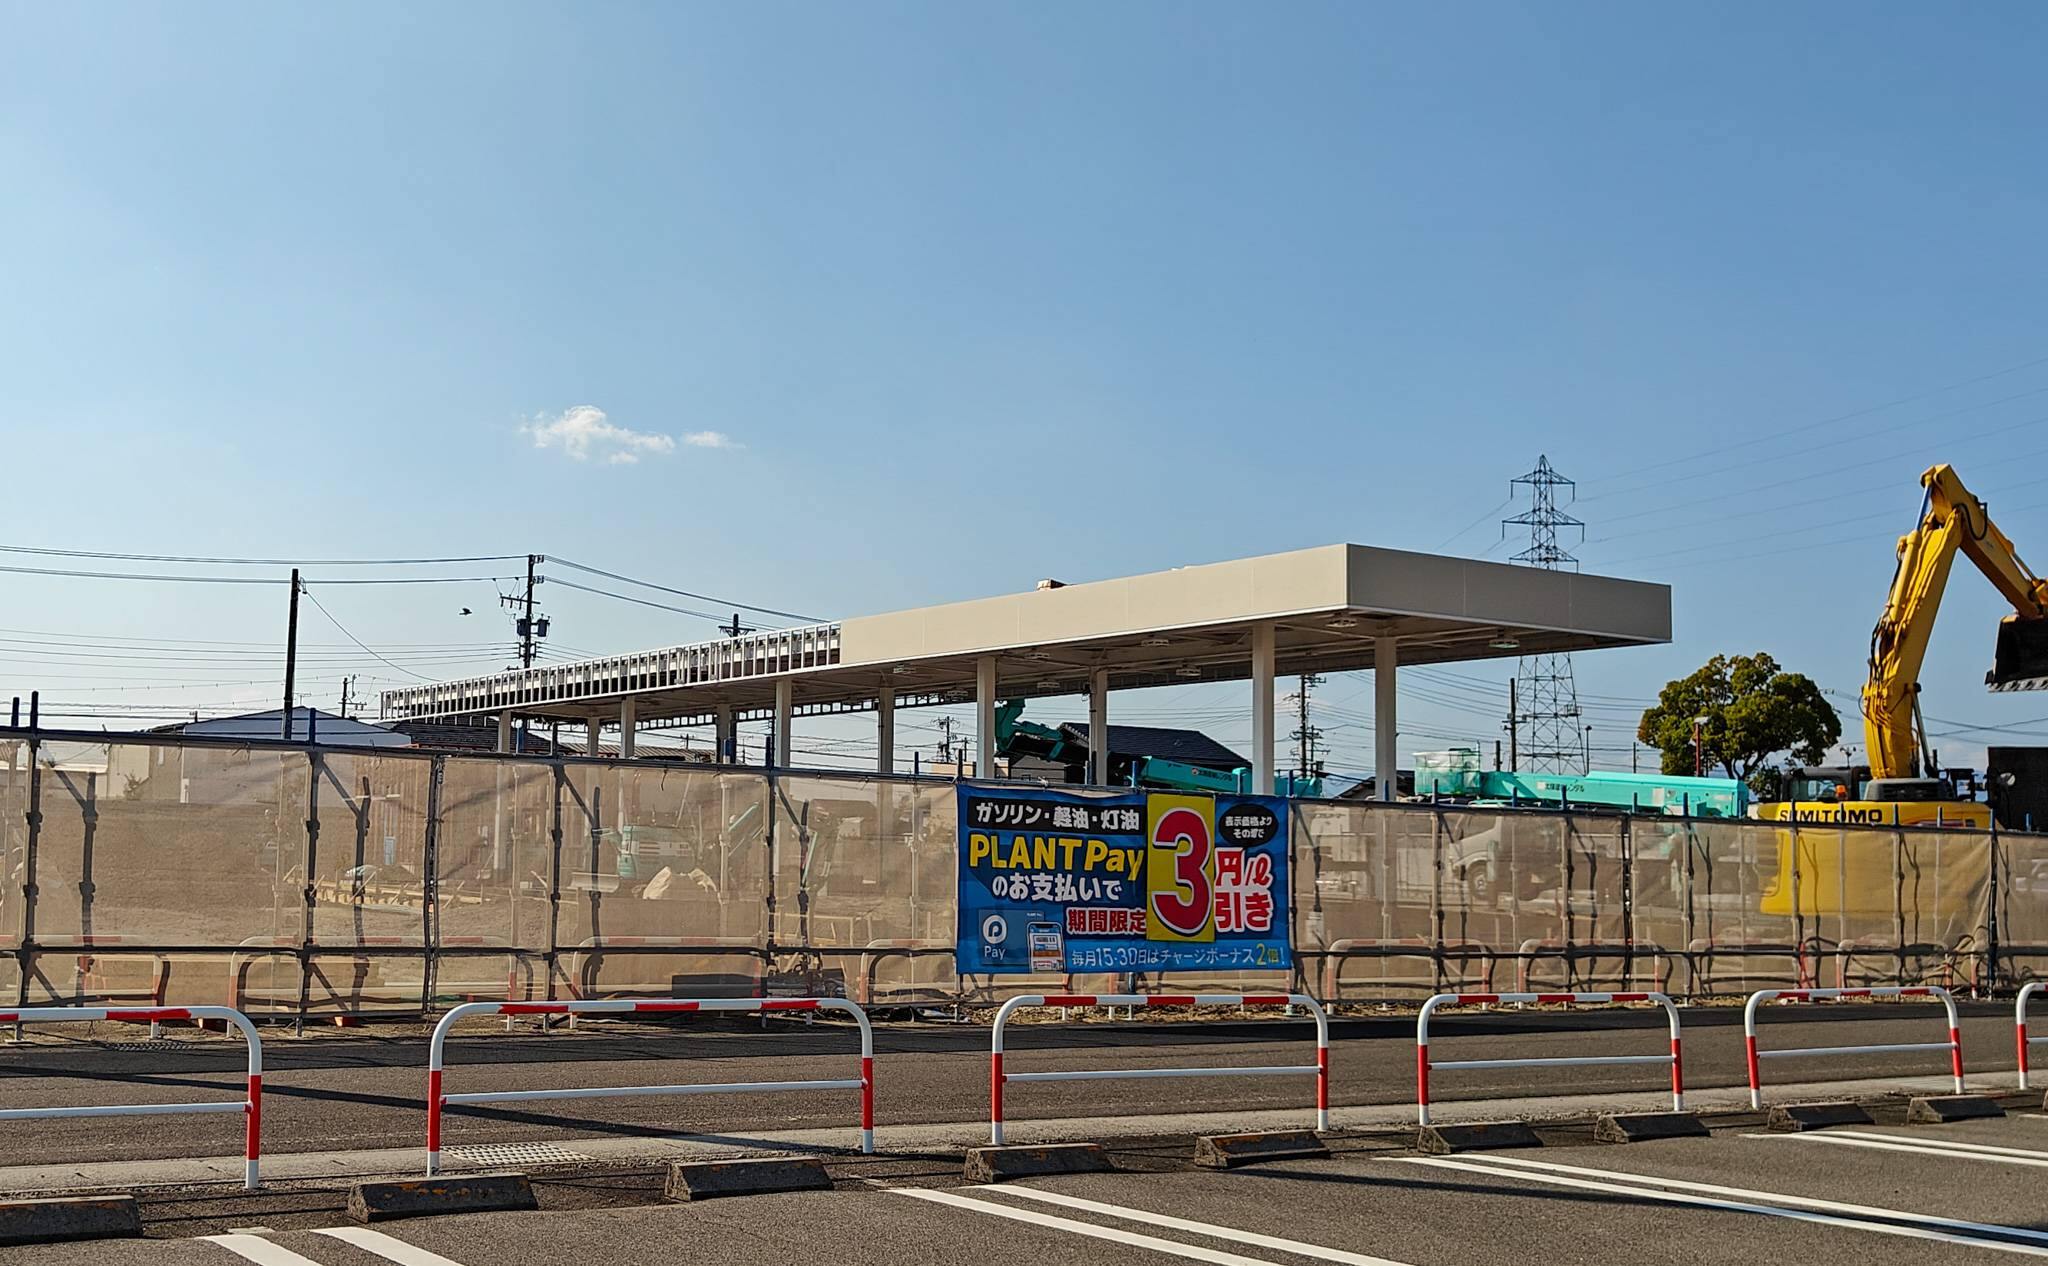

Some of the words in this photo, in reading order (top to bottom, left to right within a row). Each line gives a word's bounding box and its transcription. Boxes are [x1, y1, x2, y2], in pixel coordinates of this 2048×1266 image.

[975, 802, 1140, 831] ガソリン・軽油・灯油
[1225, 816, 1273, 827] 表示価格より
[969, 833, 1083, 871] PLANT
[1084, 839, 1145, 881] Pay
[1152, 807, 1212, 936] 3
[992, 872, 1122, 903] のお支払いで
[1066, 907, 1147, 935] 期間限定
[1215, 890, 1273, 932] 引き
[984, 945, 1006, 960] Pay
